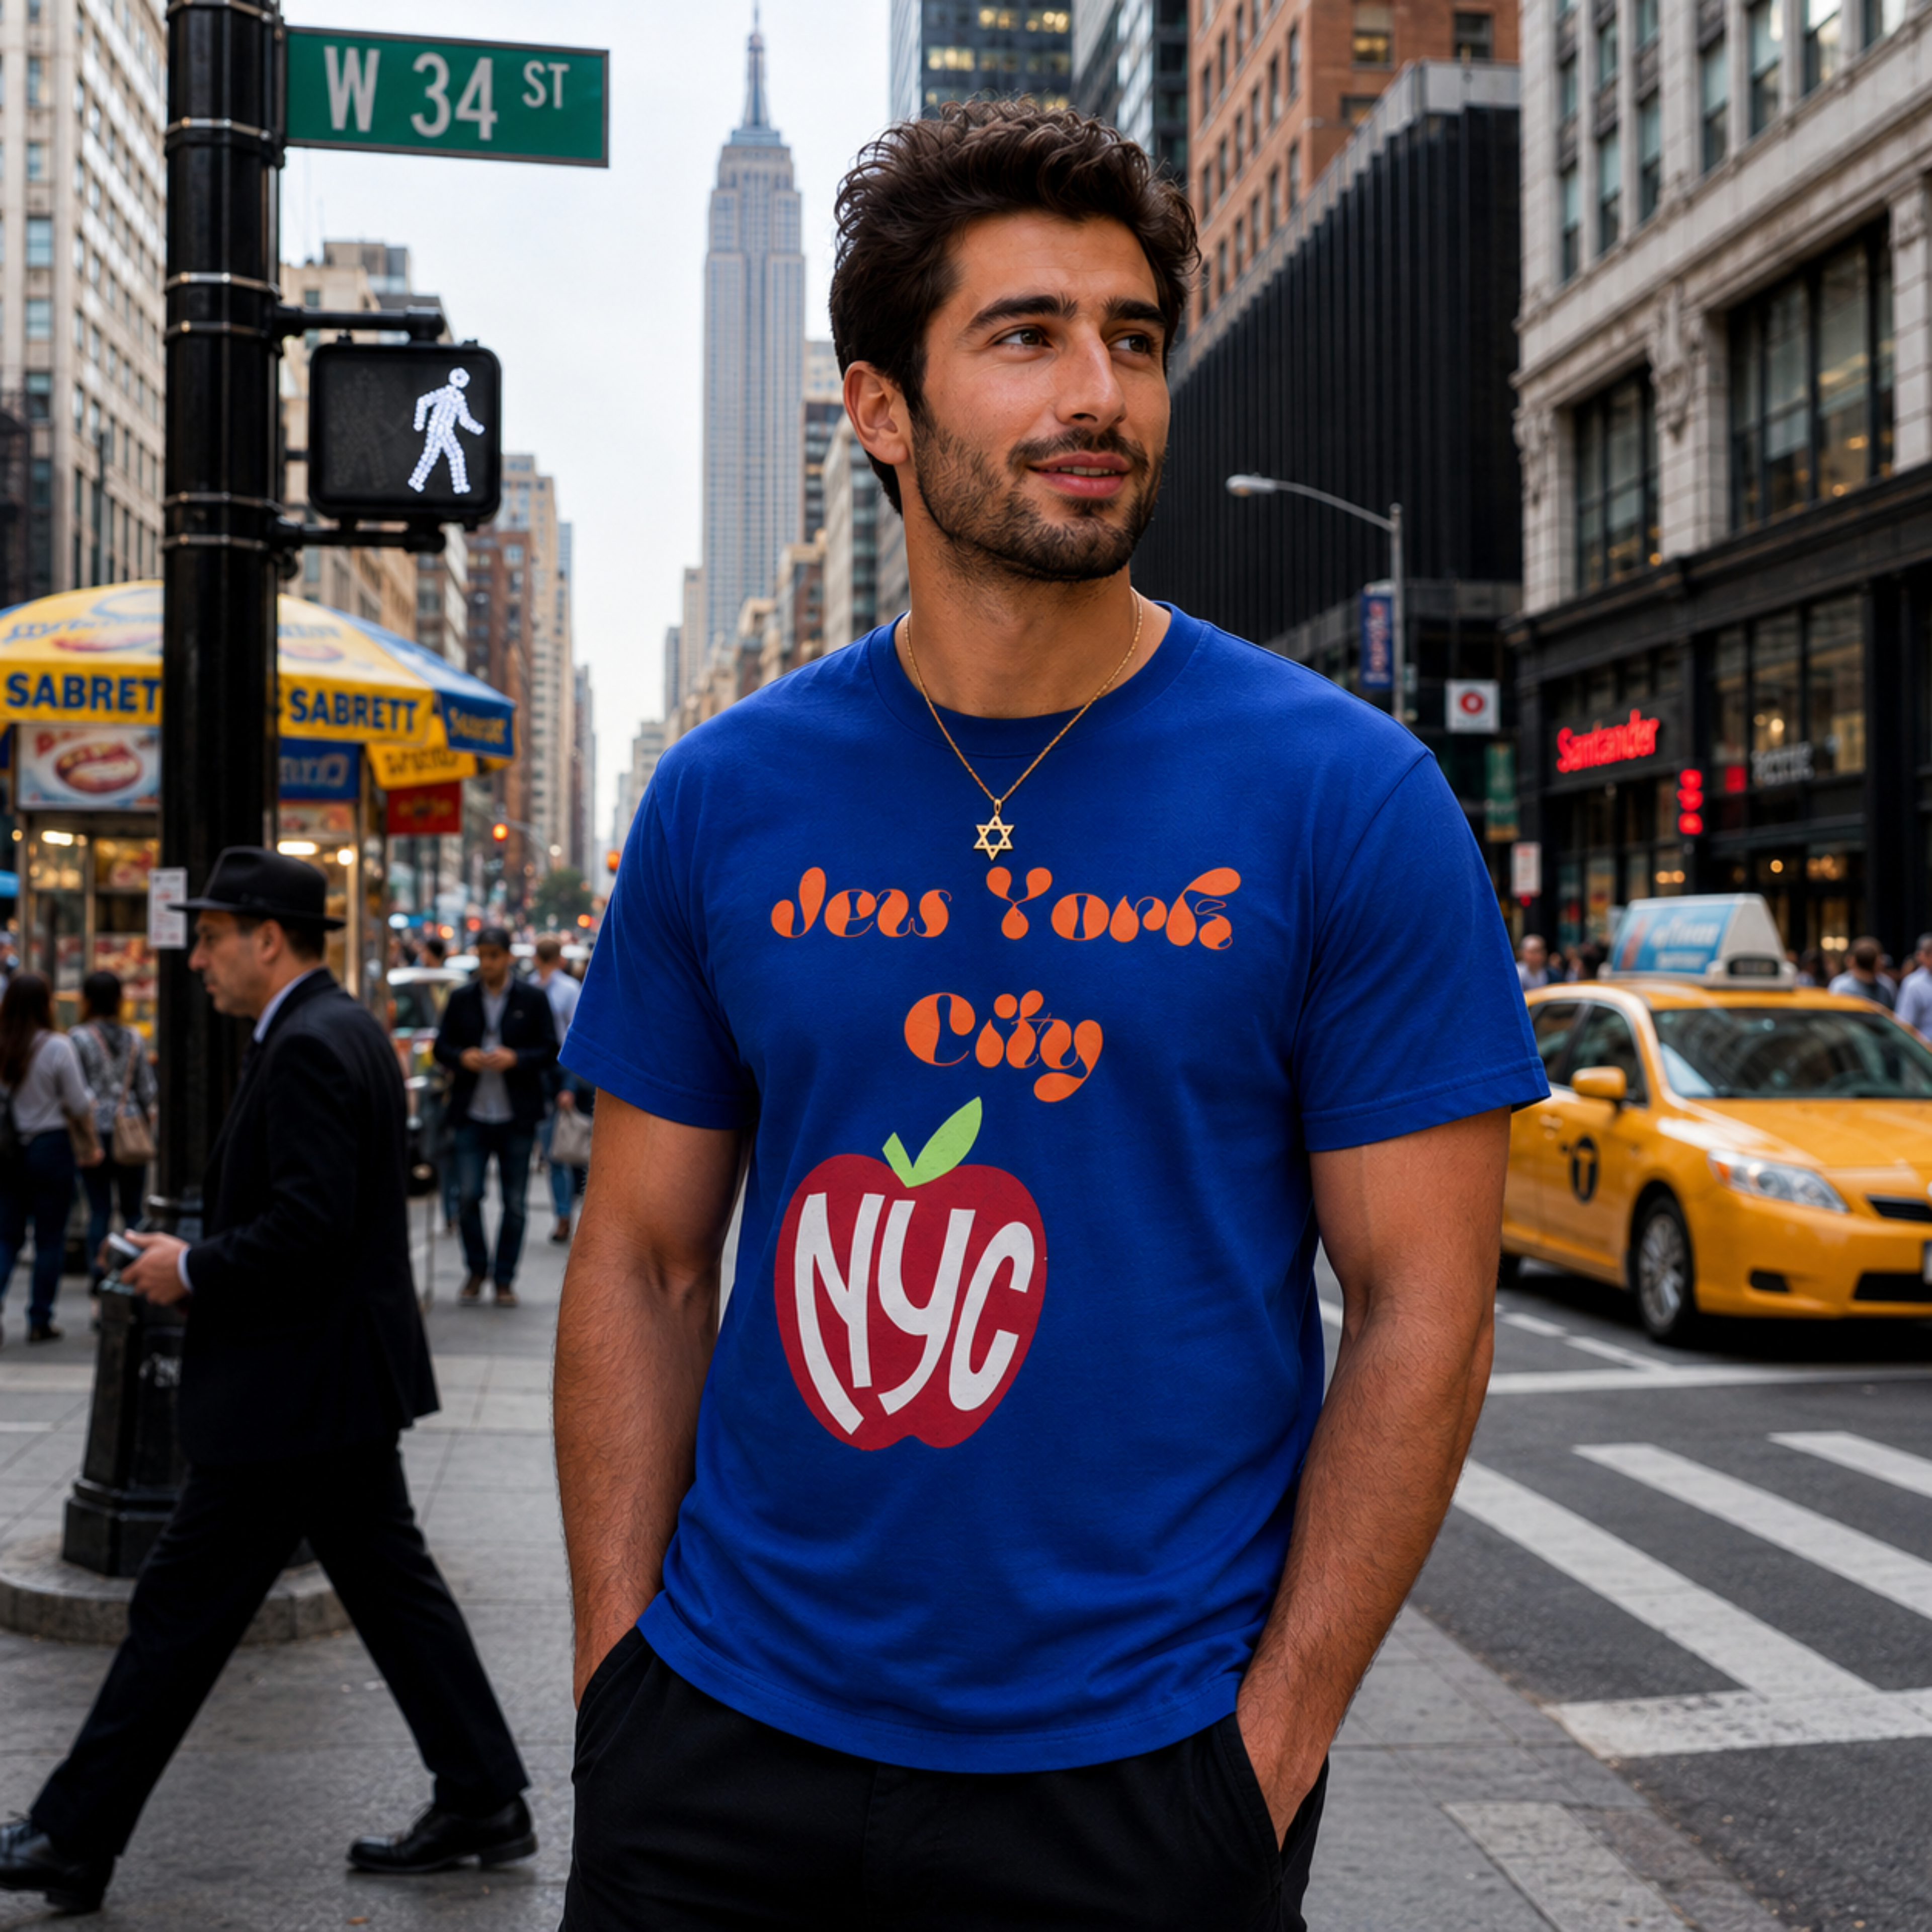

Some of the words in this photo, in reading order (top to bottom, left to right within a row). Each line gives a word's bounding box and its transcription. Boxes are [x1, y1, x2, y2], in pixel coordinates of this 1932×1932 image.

[324, 46, 380, 132] W
[411, 52, 498, 140] 34
[522, 60, 570, 109] ST
[6, 672, 162, 712] SABRET
[289, 687, 419, 734] SABRETT
[771, 866, 952, 938] Jew
[986, 866, 1241, 950] York
[904, 990, 1103, 1102] City
[794, 1192, 1035, 1435] NYC
